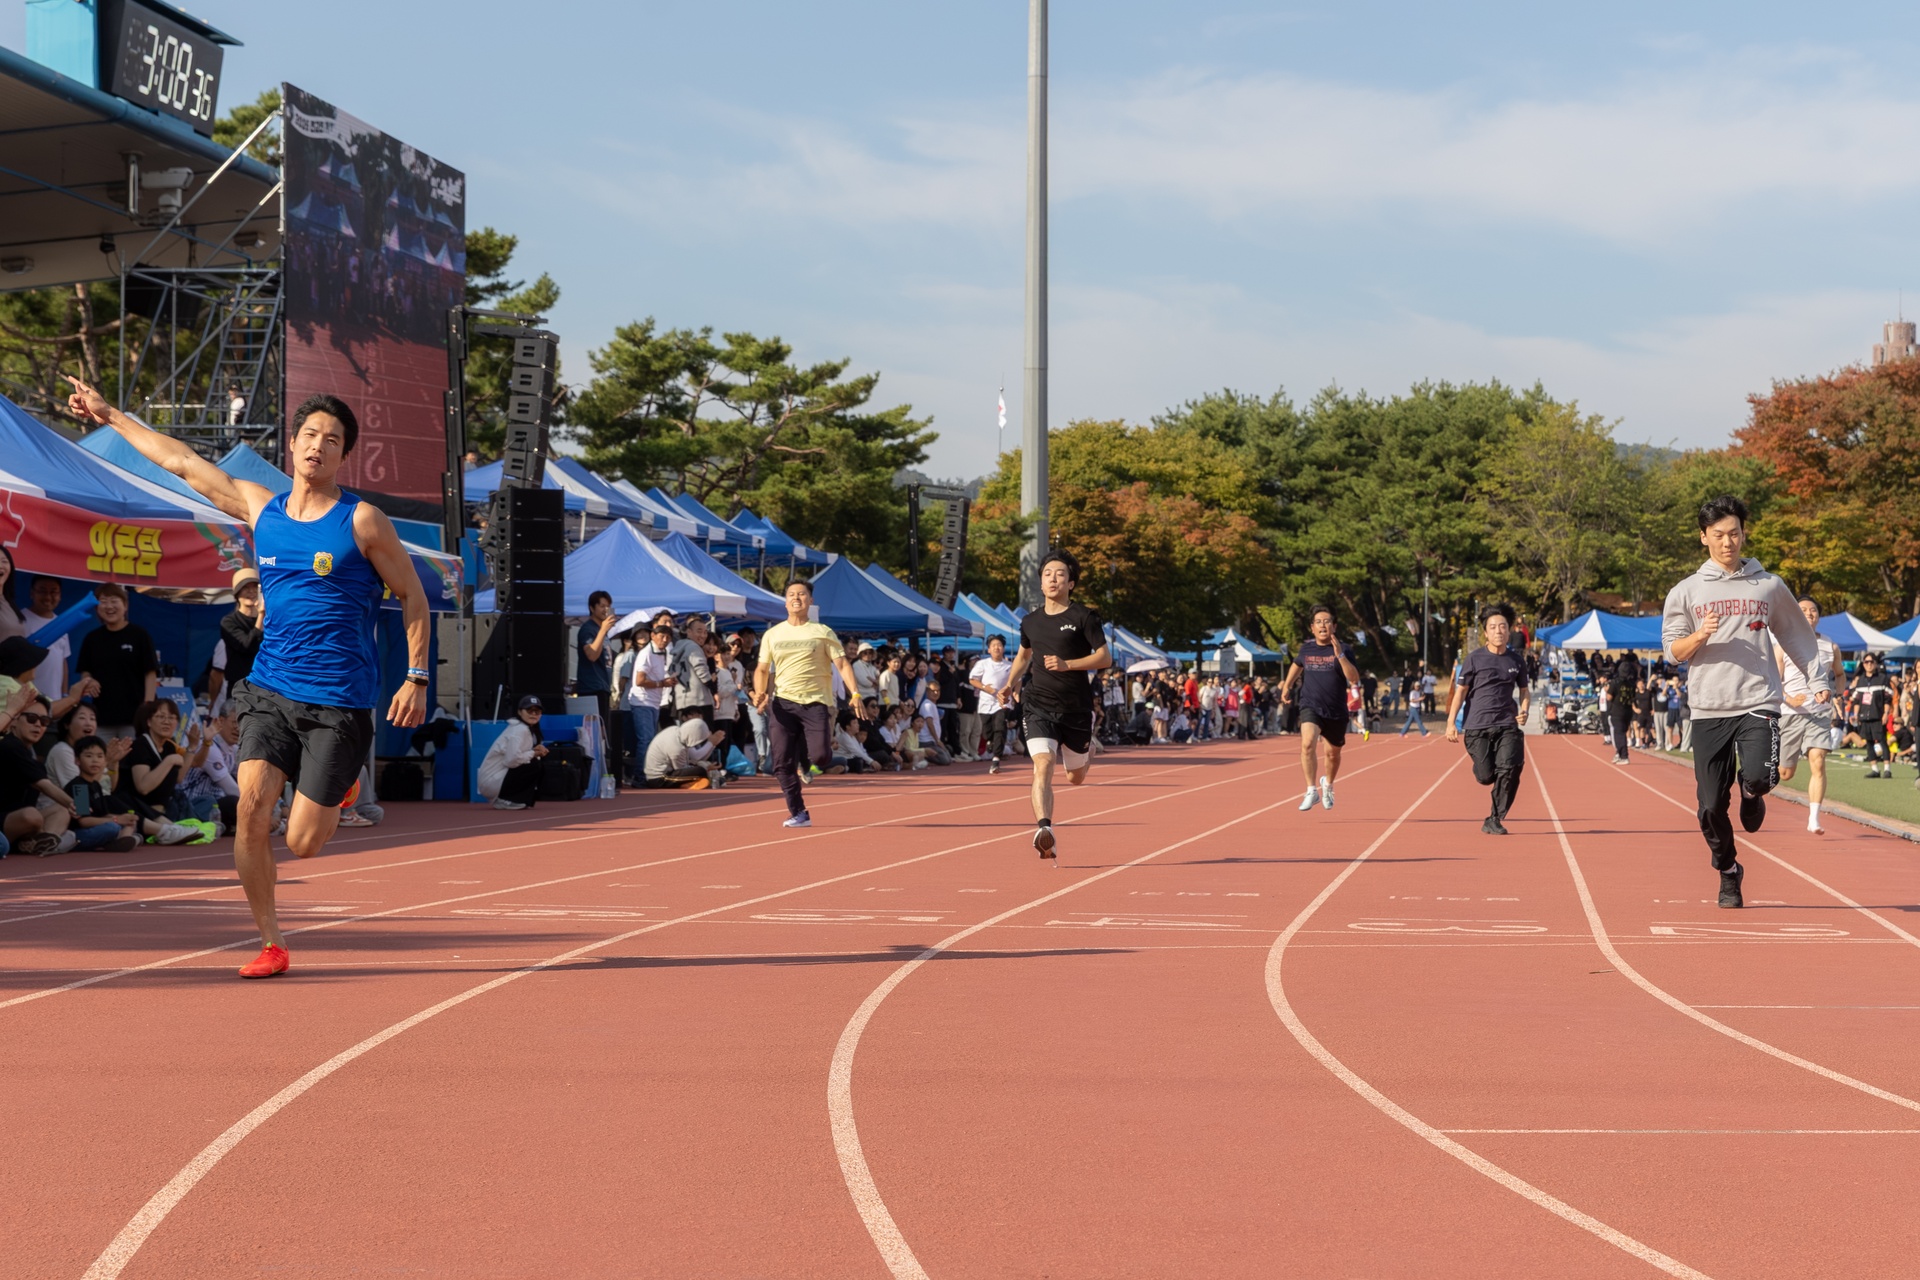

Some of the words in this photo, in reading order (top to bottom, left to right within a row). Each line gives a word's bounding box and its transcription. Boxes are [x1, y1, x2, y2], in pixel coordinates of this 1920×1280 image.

[138, 25, 193, 110] 3:08
[189, 68, 214, 121] 36
[366, 402, 382, 428] 3
[365, 441, 386, 482] 2
[87, 521, 164, 577] 의료팀
[259, 556, 277, 566] TAPOUT
[1695, 599, 1769, 619] RAZORBACKS
[774, 640, 815, 650] FLEXFIT
[1044, 917, 1242, 927] 4
[1347, 922, 1548, 933] 3
[1649, 926, 1851, 937] 2
